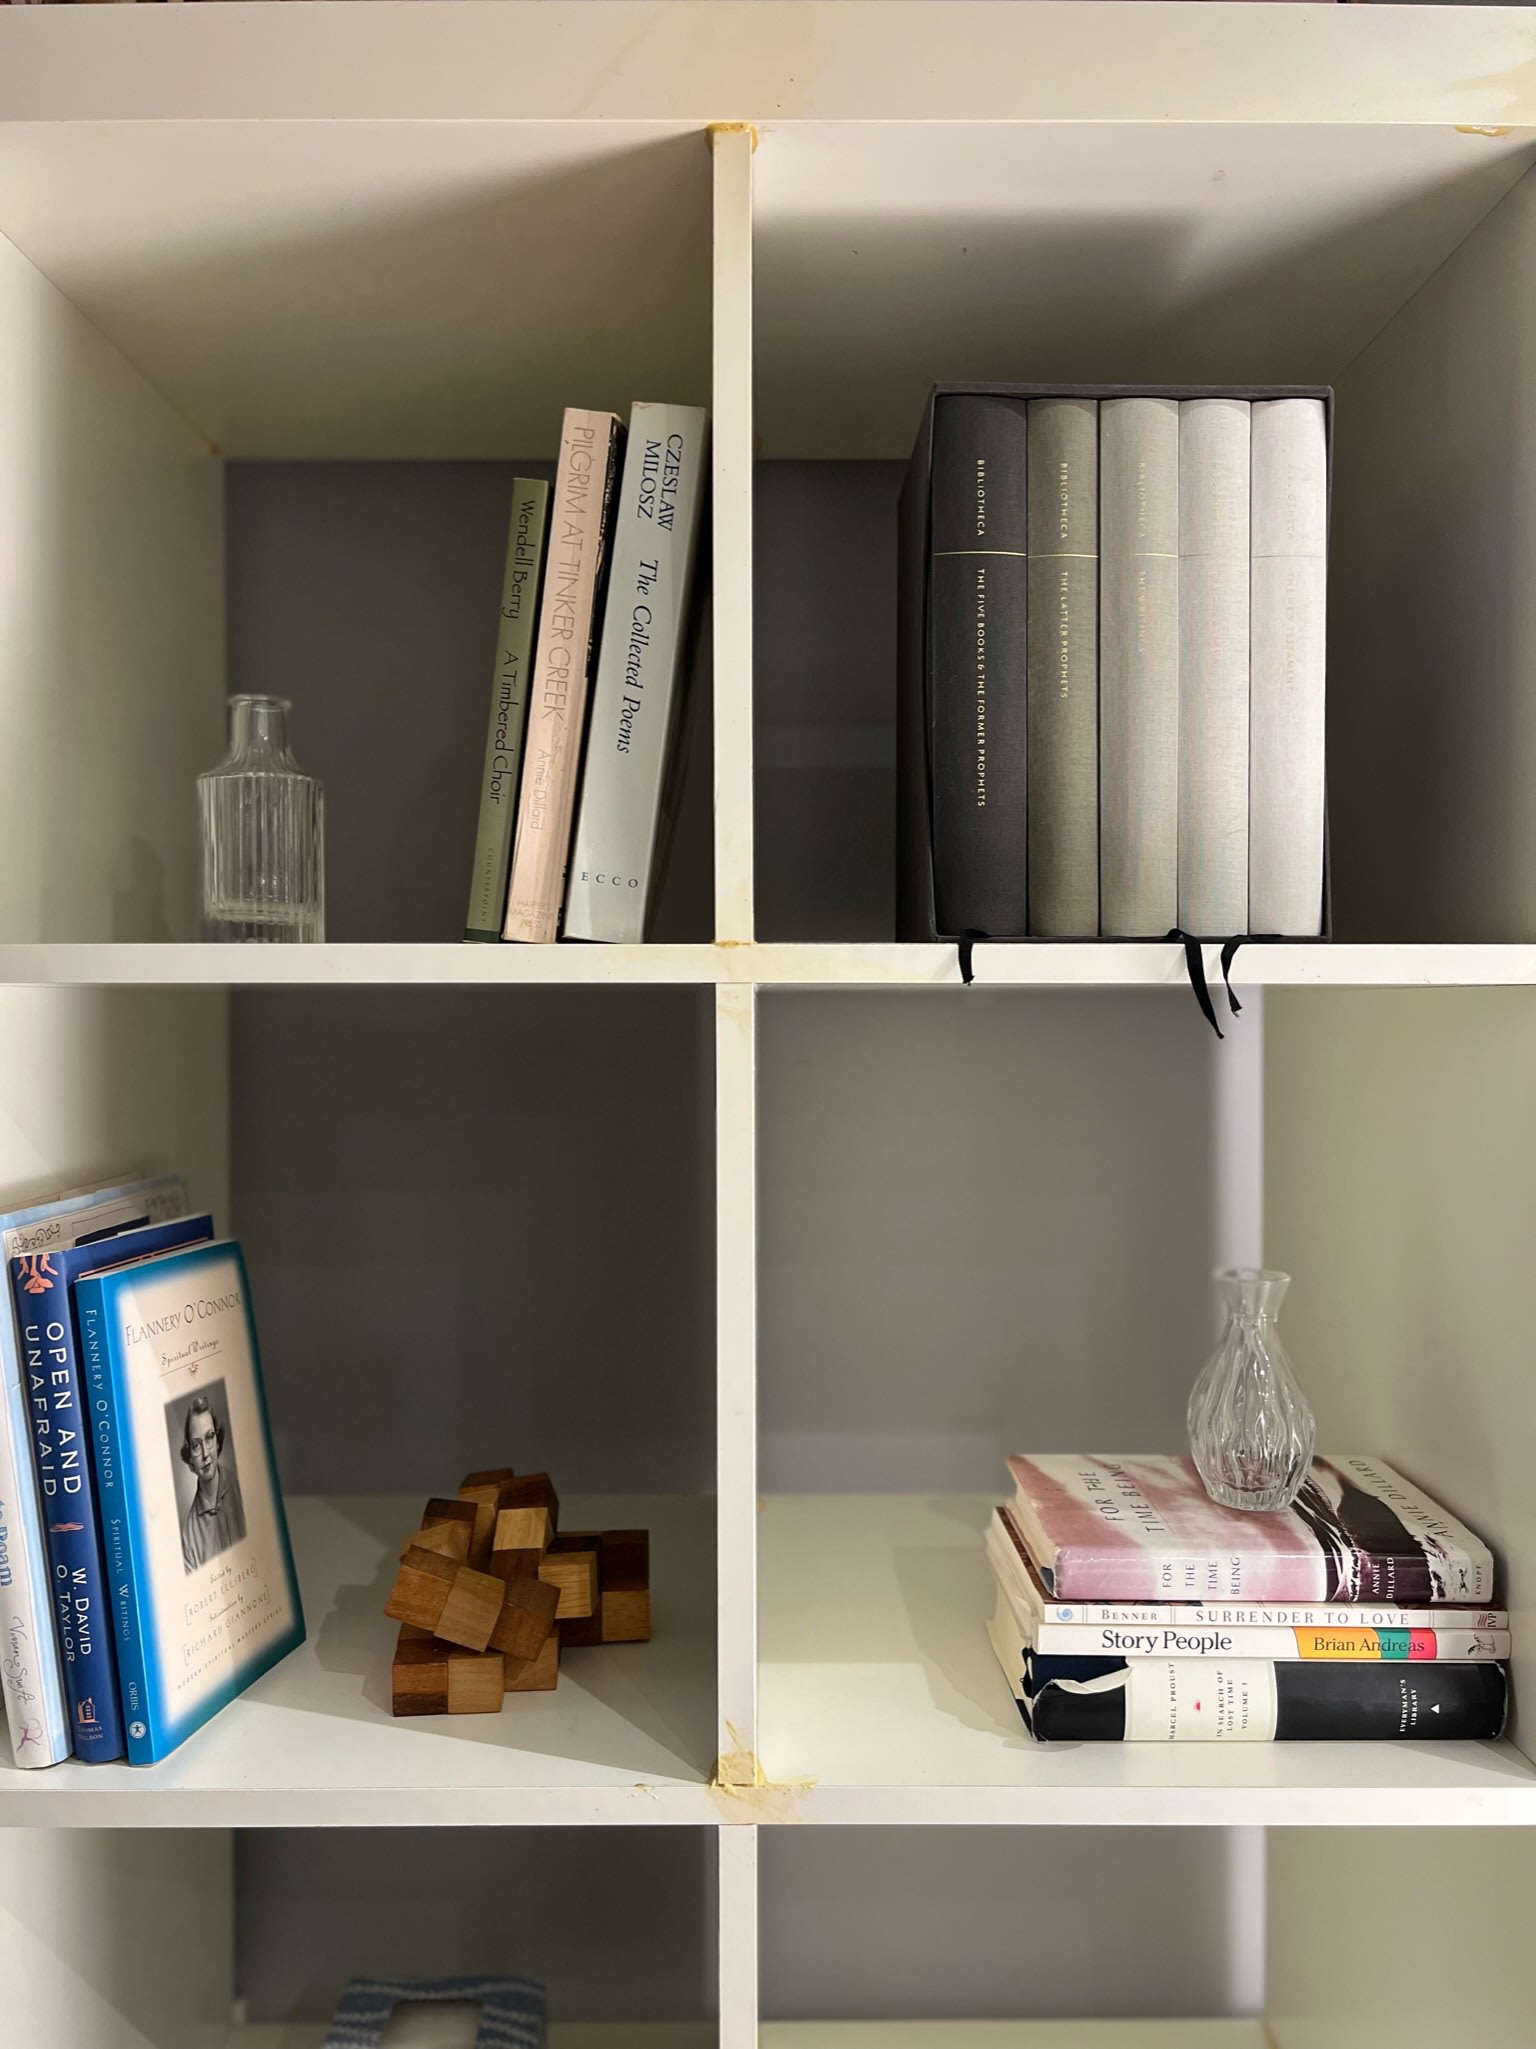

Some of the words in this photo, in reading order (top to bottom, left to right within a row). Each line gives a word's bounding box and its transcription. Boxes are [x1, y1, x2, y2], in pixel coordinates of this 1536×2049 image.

[566, 427, 595, 515] PILGRIM
[636, 439, 661, 519] MILOSZ
[657, 433, 684, 532] CZESLAW
[977, 459, 985, 536] BIBLIOTHECA
[1060, 463, 1069, 539] BIBLIOTHECA
[514, 500, 535, 566] Wendell
[561, 520, 585, 551] AT
[503, 570, 528, 619] Berry
[636, 560, 659, 596] The
[977, 569, 985, 590] THE
[1060, 571, 1068, 593] THE
[551, 560, 581, 641] TINKER
[977, 595, 985, 618] FIVE
[1060, 596, 1069, 637] LATTER
[503, 650, 519, 665] A
[625, 605, 652, 689] Collected
[977, 623, 985, 660] BOOKS
[542, 646, 571, 721] CREEK
[977, 673, 985, 695] THE
[1060, 640, 1069, 698] PROPHETS
[495, 670, 519, 751] Timbered
[617, 696, 641, 754] Poems
[977, 699, 985, 745] FORMER
[489, 755, 512, 805] Choir
[535, 749, 551, 786] Annie
[977, 749, 986, 807] PROPHETS
[530, 789, 547, 830] Dillard
[581, 871, 639, 889] ECCO
[125, 1311, 181, 1347] FLANNERY
[46, 1322, 73, 1410] OPEN
[161, 1345, 192, 1368] Spiritual
[25, 1325, 57, 1495] UNAFRAID
[85, 1309, 104, 1390] FLANNERY
[96, 1400, 115, 1488] O'CONNOR
[58, 1428, 82, 1494] AND
[1078, 1471, 1105, 1492] THE
[1103, 1464, 1141, 1497] BEING
[1349, 1460, 1407, 1500] DILLARD
[1094, 1498, 1125, 1522] FOR
[1130, 1503, 1165, 1533] TIME
[1400, 1504, 1454, 1539] ANNIE
[56, 1564, 68, 1583] O.
[72, 1567, 88, 1591] W.
[110, 1518, 124, 1575] SPIRITUAL
[118, 1583, 131, 1641] WRITINGS
[1162, 1563, 1172, 1588] FOR
[1185, 1563, 1195, 1587] THE
[1208, 1561, 1218, 1590] TIME
[1230, 1557, 1241, 1595] BEING
[1371, 1563, 1380, 1594] ANNIE
[1386, 1557, 1395, 1599] DILLARD
[59, 1592, 75, 1662] TAYLOR
[75, 1598, 92, 1655] DAVID
[1101, 1609, 1157, 1621] BENNER
[1195, 1610, 1314, 1624] SURRENDER
[1324, 1612, 1349, 1625] TO
[1360, 1613, 1410, 1626] LOVE
[1487, 1612, 1497, 1628] IVP
[1101, 1629, 1159, 1654] Story
[1163, 1630, 1233, 1655] People
[1313, 1637, 1356, 1652] Brian
[1359, 1637, 1425, 1652] Andreas
[128, 1681, 139, 1711] ORBIS
[1168, 1663, 1177, 1702] PROUST
[1217, 1670, 1223, 1685] OF
[1168, 1706, 1177, 1740] MARCEL
[1217, 1728, 1223, 1738] IN
